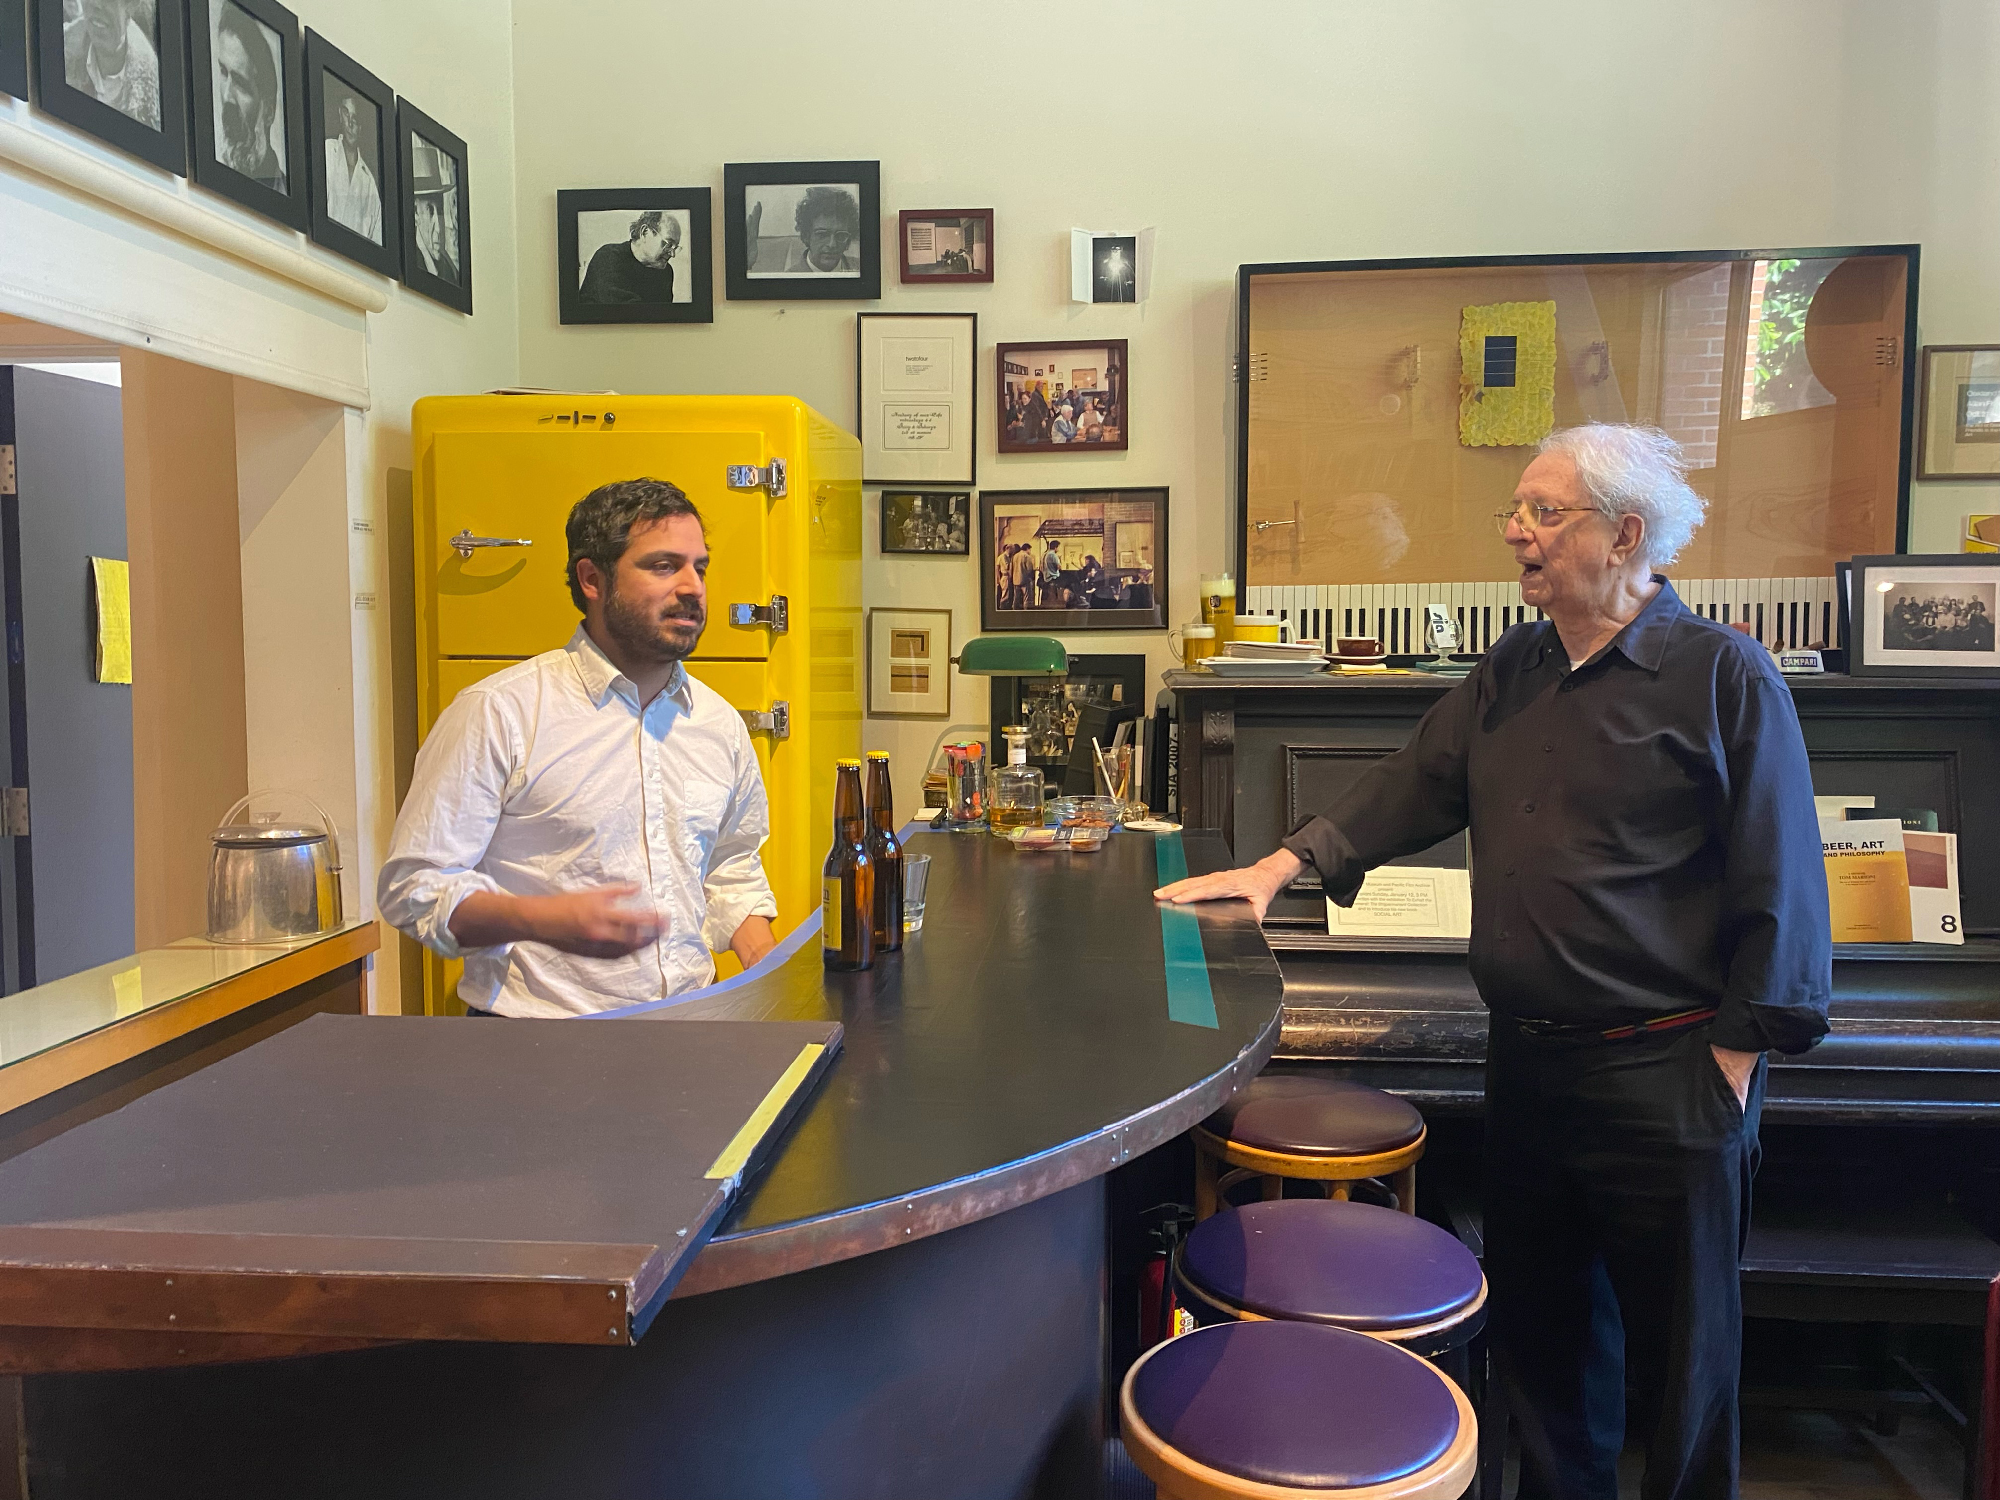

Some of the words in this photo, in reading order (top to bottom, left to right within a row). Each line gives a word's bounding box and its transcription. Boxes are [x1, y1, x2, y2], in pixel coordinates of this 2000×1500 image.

[1822, 842, 1857, 851] BEER,
[1861, 841, 1884, 849] ART
[1941, 914, 1957, 933] 8
